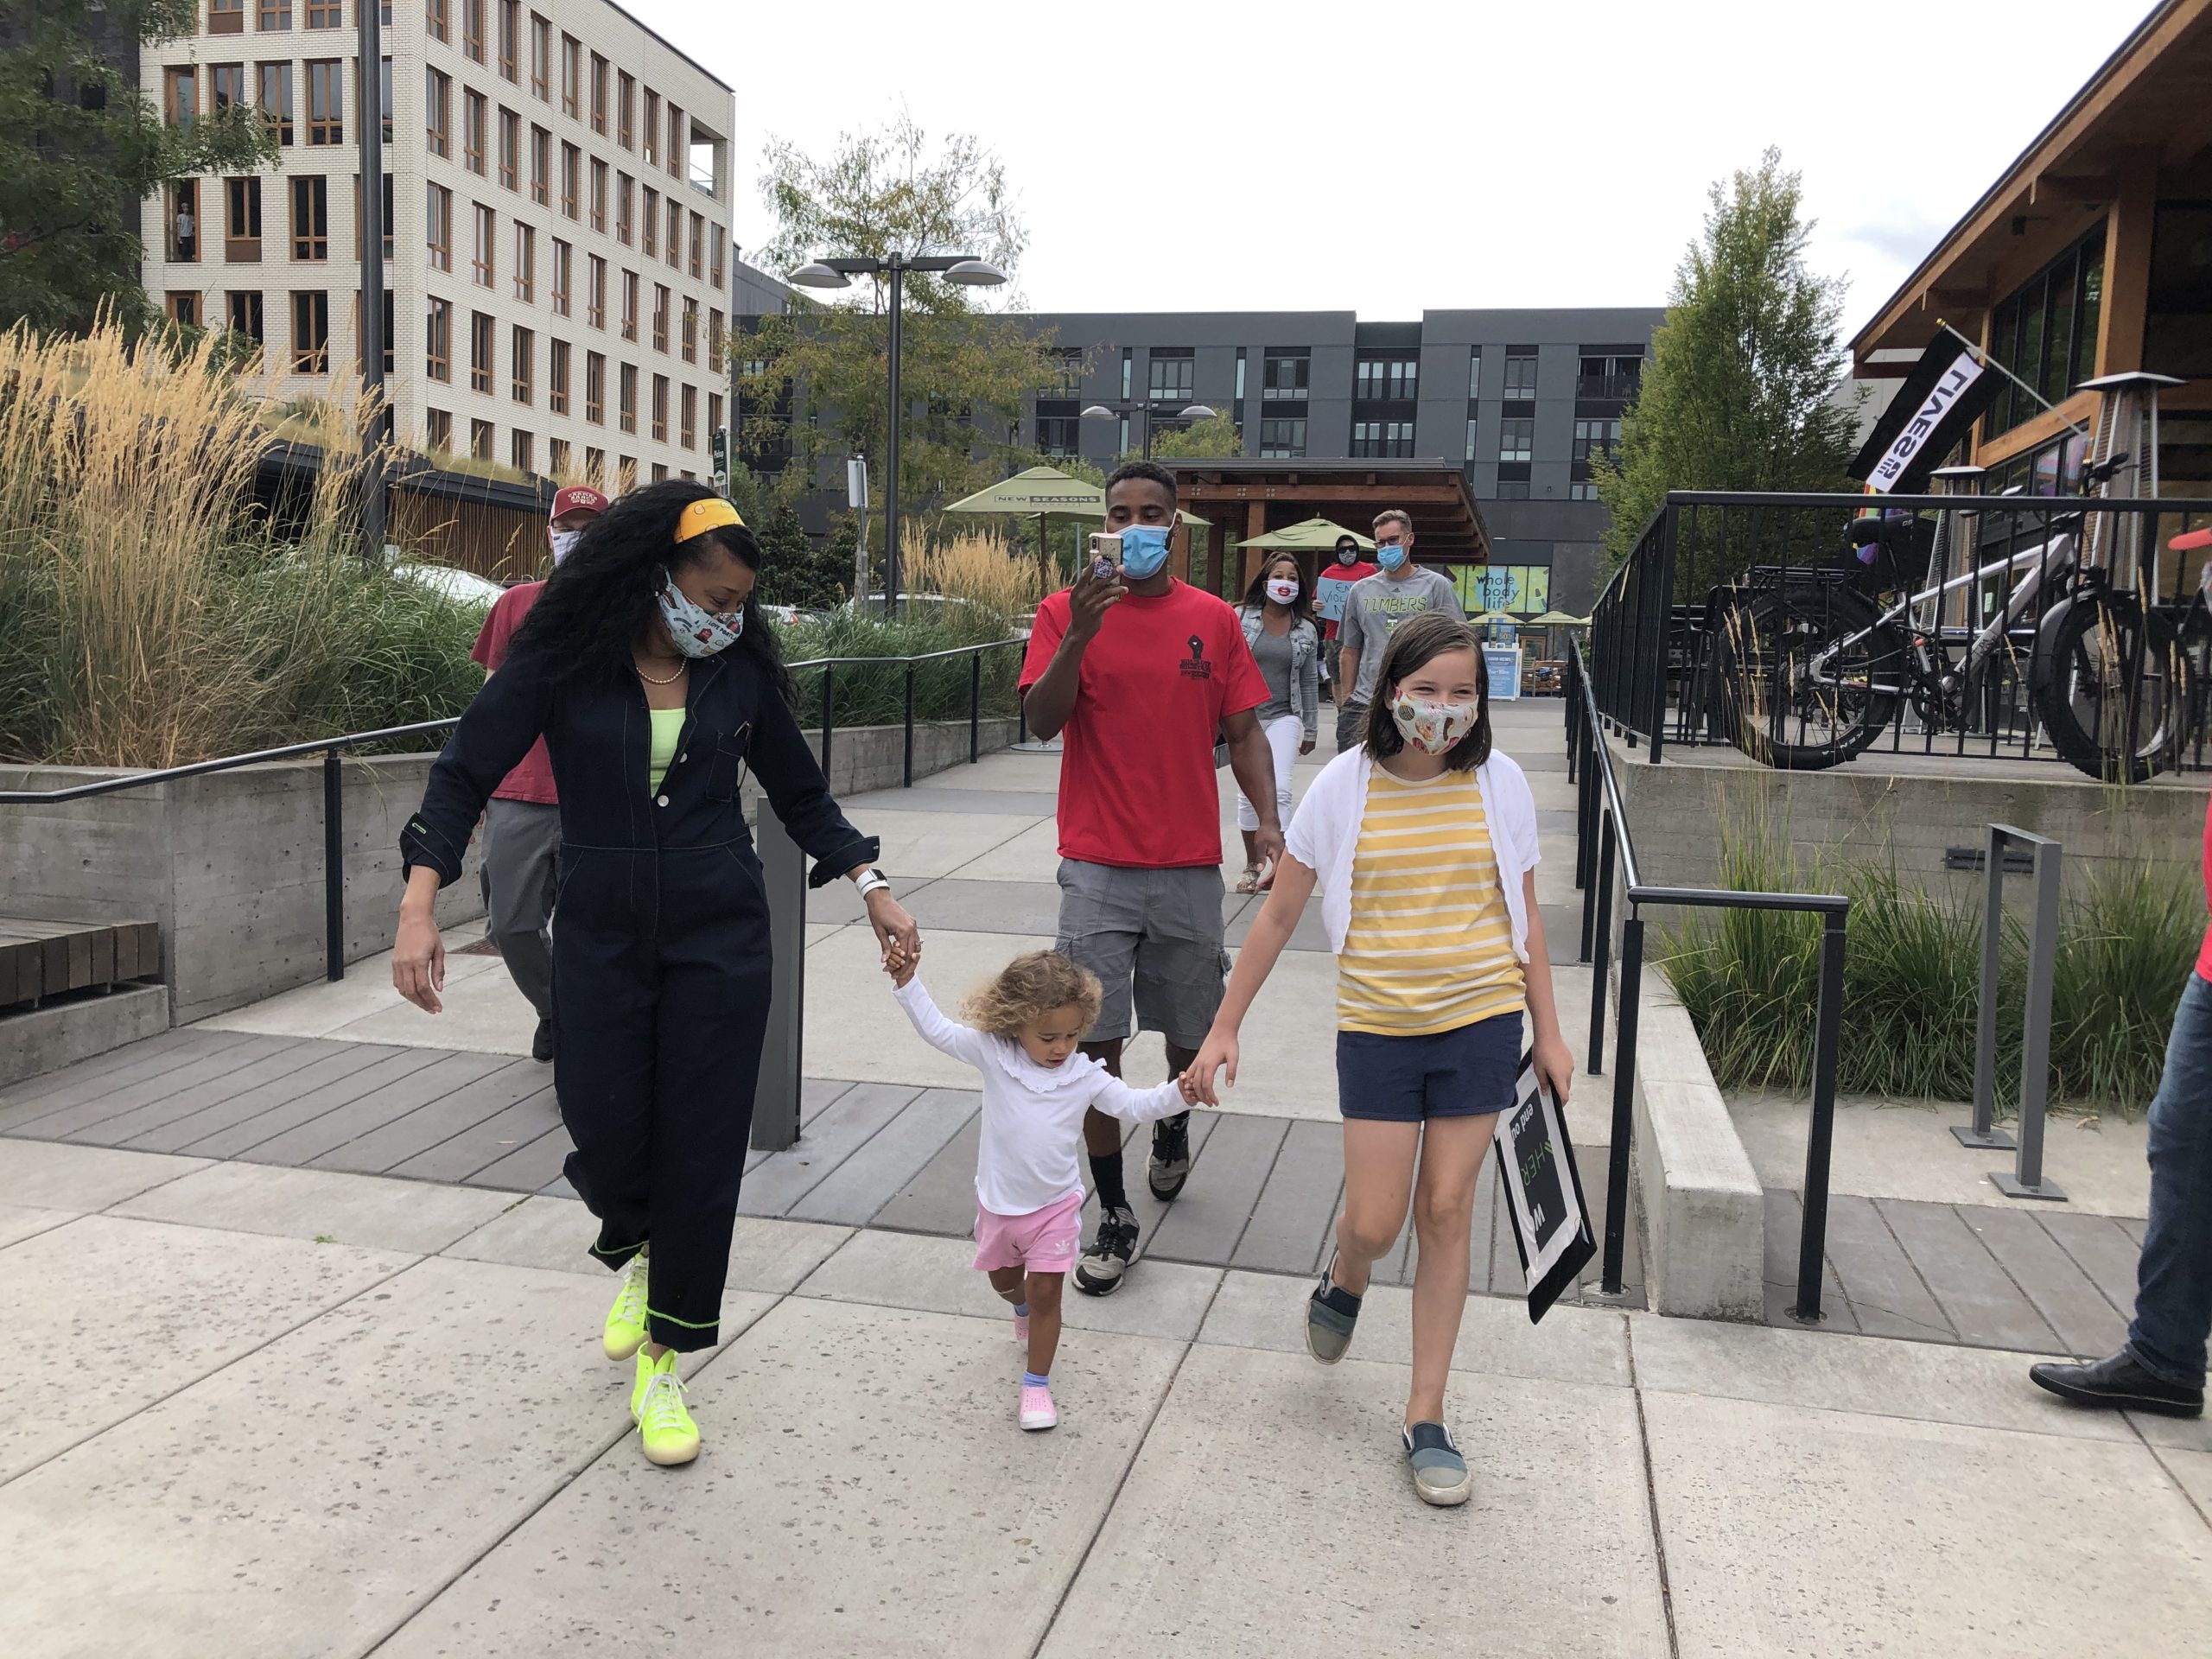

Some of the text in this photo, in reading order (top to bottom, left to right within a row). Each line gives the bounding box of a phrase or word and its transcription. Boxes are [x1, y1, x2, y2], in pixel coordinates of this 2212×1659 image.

[1476, 572, 1515, 585] whole
[1483, 583, 1520, 601] body
[1363, 595, 1427, 614] TIMBERS
